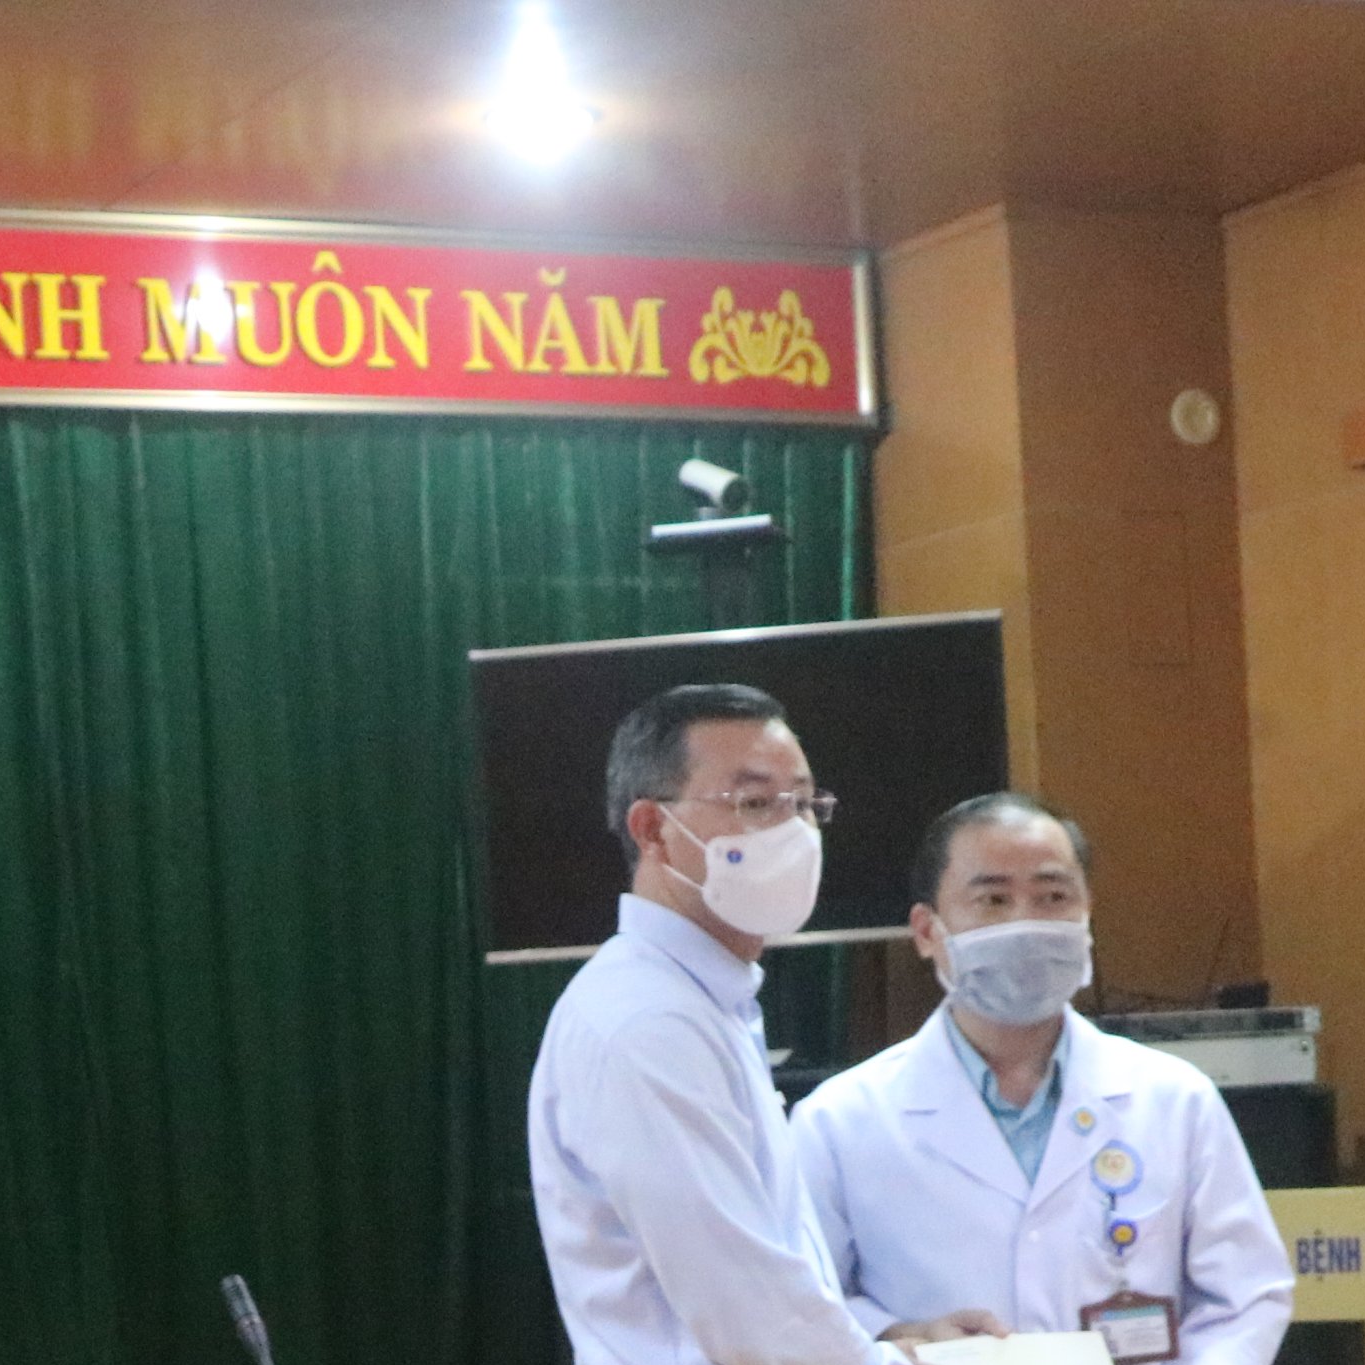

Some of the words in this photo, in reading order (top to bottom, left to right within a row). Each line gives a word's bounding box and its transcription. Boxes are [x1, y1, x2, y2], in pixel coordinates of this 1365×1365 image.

[137, 250, 432, 369] MUÔN
[460, 267, 669, 377] NĂM
[1296, 1229, 1361, 1281] BỆNH
